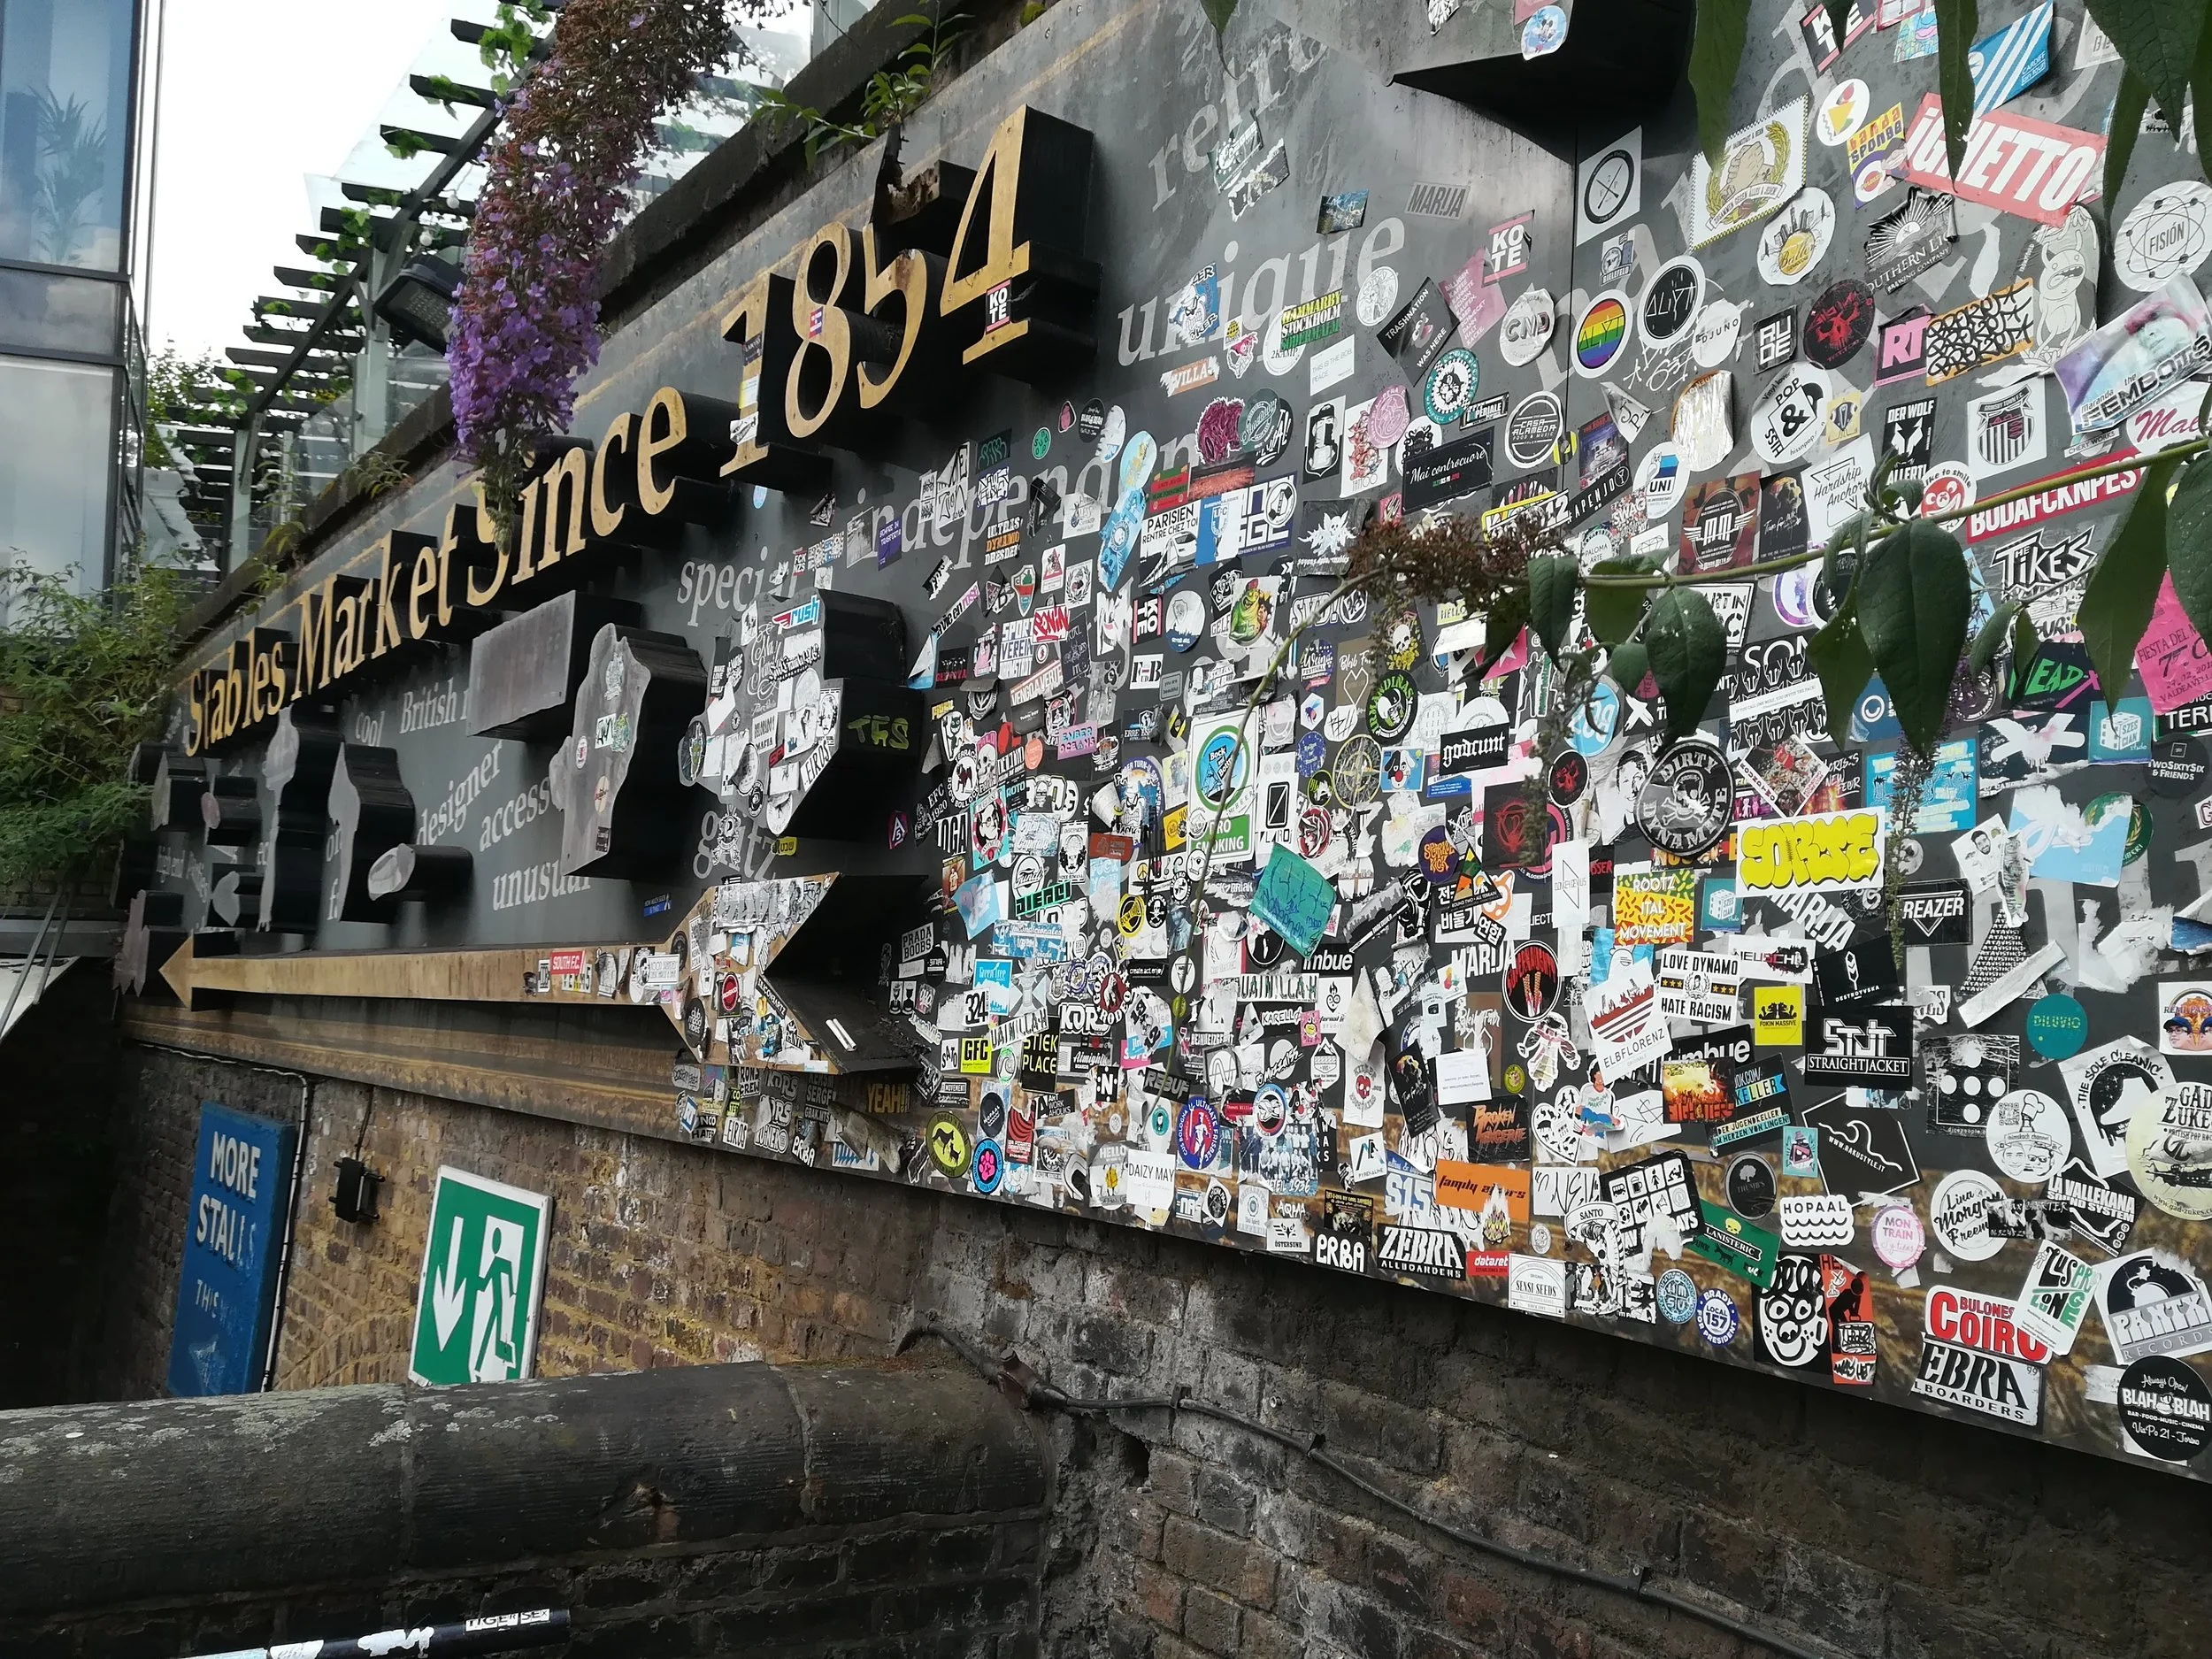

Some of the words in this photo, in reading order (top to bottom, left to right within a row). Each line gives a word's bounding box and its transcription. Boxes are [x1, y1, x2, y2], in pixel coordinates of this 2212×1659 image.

[2022, 50, 2047, 75] CARDIFF
[1493, 223, 1525, 251] KO
[2148, 220, 2185, 257] FISIÓN
[1491, 247, 1522, 273] TE
[1867, 242, 1931, 292] OUTHERN
[1886, 268, 1917, 293] BREWING
[1916, 246, 1951, 277] COMPANY
[1602, 266, 1631, 285] BIELEFELD
[989, 285, 1008, 308] KO
[1282, 291, 1341, 324] HAMMARBY
[988, 303, 1007, 322] TE
[1282, 304, 1341, 338] STOCKHOLM
[1385, 289, 1430, 341] TRASHNATION
[1701, 318, 1740, 344] DJUNO
[1759, 317, 1791, 341] RU
[1416, 346, 1436, 368] WAS
[1429, 327, 1448, 354] HERE
[1759, 338, 1791, 365] DE
[1882, 316, 1932, 369] RT
[2080, 334, 2212, 428] FEMBOTS
[2124, 373, 2137, 387] the
[1775, 377, 1801, 407] POP
[1887, 406, 1907, 423] DER
[1907, 400, 1935, 419] WOLF
[185, 628, 286, 757] Stables
[291, 503, 458, 701] Market
[466, 386, 687, 607] Since
[720, 104, 1030, 477] 1854
[1511, 424, 1557, 435] ALAMEDA
[1520, 419, 1546, 429] CASA
[1764, 427, 1785, 457] HISS
[2091, 431, 2116, 445] WORKS
[1409, 466, 1429, 485] Mai
[1649, 479, 1673, 494] UNI
[1814, 465, 1863, 499] Hardship
[1953, 469, 1971, 488] smile
[1827, 478, 1869, 506] Anchors
[1147, 504, 1194, 533] PARISIEN
[1613, 495, 1646, 524] SWAG
[987, 531, 1019, 551] DYNAMO
[1142, 527, 1169, 544] RENTRE
[1168, 524, 1184, 536] CHEZ
[795, 553, 806, 565] FCK
[1584, 542, 1609, 557] PALOMA
[1590, 554, 1603, 563] ARTE
[677, 547, 796, 626] specil
[962, 584, 979, 611] rose
[790, 595, 819, 626] rush
[1002, 618, 1034, 641] SPORT
[1001, 637, 1033, 657] VEREIN
[2137, 641, 2170, 663] FIESTA
[2169, 629, 2188, 645] DEL
[1302, 664, 1325, 674] FESTIVAL
[356, 710, 385, 746] cool
[401, 678, 457, 734] British
[756, 736, 772, 750] MAFIA
[1660, 751, 1720, 780] DIRTY
[1825, 772, 1845, 787] NEW
[417, 739, 503, 846] designer
[927, 784, 945, 809] EFC
[931, 799, 948, 821] 1920
[1641, 787, 1728, 849] DYNAMITE
[1428, 856, 1450, 874] KICK
[1632, 876, 1676, 895] ROOTZ
[1640, 901, 1665, 916] ITAL
[1903, 897, 1964, 919] REAZER
[1440, 908, 1478, 932] 비둘기
[1477, 917, 1503, 944] 연합
[902, 928, 932, 944] PRADA
[1619, 924, 1686, 941] MOVEMENT
[903, 940, 932, 957] BOOBS
[553, 954, 571, 970] SOUTH
[571, 955, 580, 969] F.C.
[1663, 952, 1690, 971] LOVE
[1693, 956, 1738, 976] DYNAMO
[965, 991, 988, 1025] 324
[1662, 996, 1686, 1016] HATE
[1689, 1002, 1732, 1021] RACISM
[964, 1039, 988, 1062] GFC
[1603, 1027, 1665, 1069] ELBFLORENZ
[1021, 1053, 1057, 1075] PLACE
[1809, 1056, 1908, 1073] STRAIGHTJACKET
[2078, 1083, 2090, 1102] THE
[2085, 1056, 2108, 1080] SOLE
[2110, 1048, 2161, 1076] CLEANIC
[1048, 1100, 1065, 1110] WORK
[1735, 1082, 1778, 1106] KELLER
[1195, 1100, 1217, 1125] ULTIMATE
[1717, 1124, 1730, 1136] DER
[1731, 1109, 1780, 1132] JUGENDKELLER
[1723, 1130, 1747, 1143] HERZEN
[1762, 1115, 1791, 1133] LINGEN!
[1204, 1127, 1219, 1161] FRISBEE
[1829, 1135, 1886, 1172] WWW.RAKUSTYLE.IT
[211, 1131, 260, 1200] MORE
[1128, 1162, 1154, 1177] DAIZY
[1156, 1166, 1175, 1182] MAY
[1289, 1178, 1310, 1193] 1936
[1438, 1174, 1479, 1194] family
[1783, 1202, 1847, 1215] HOPAAL
[2065, 1179, 2135, 1217] VALLEKANA
[1579, 1208, 1603, 1220] SANTO
[1886, 1217, 1911, 1229] MON
[2087, 1202, 2134, 1224] SYSTEM
[1274, 1240, 1302, 1248] ÖSTERSUND
[1705, 1227, 1755, 1256] LANISTERIC
[1882, 1226, 1914, 1240] TRAIN
[1382, 1225, 1464, 1270] ZEBRA
[1381, 1260, 1461, 1279] ALLBOARDERS
[1474, 1254, 1509, 1267] dataset
[1517, 1279, 1534, 1292] SENSI
[1535, 1283, 1556, 1296] SEEDS
[1703, 1288, 1733, 1308] BRADY
[1706, 1305, 1728, 1317] LOCAL
[1960, 1297, 2016, 1320] BULONES
[1706, 1312, 1727, 1329] 157
[1702, 1319, 1738, 1346] PRESIDENT
[2141, 1372, 2166, 1389] Always
[2167, 1375, 2188, 1393] Open!
[2123, 1388, 2157, 1412] BLAH
[2172, 1397, 2210, 1423] BLAH
